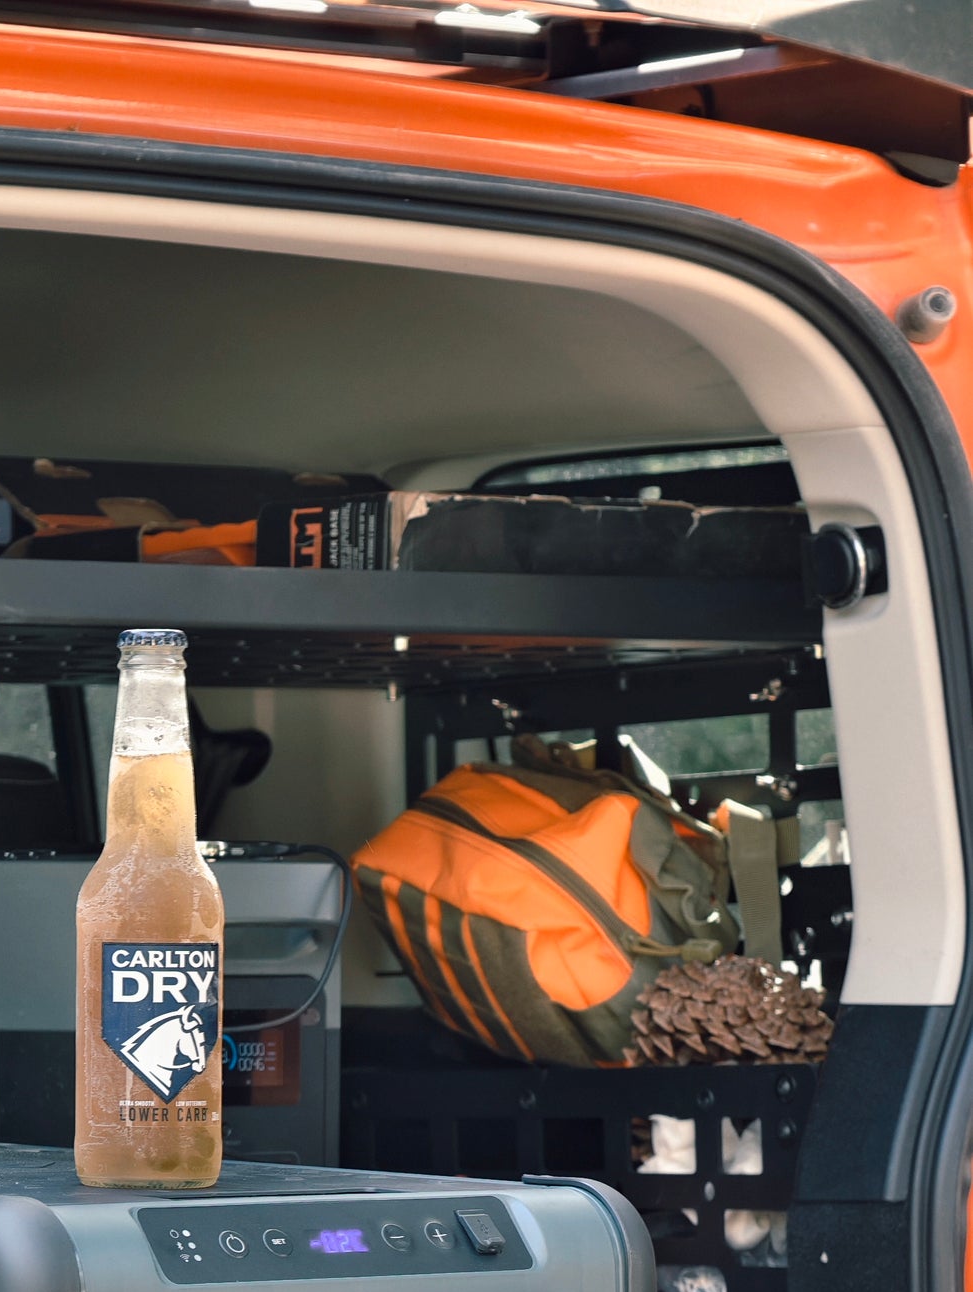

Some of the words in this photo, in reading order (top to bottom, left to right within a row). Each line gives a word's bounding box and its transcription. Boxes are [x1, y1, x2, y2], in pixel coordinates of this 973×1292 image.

[112, 949, 215, 968] CARLTON
[111, 970, 215, 1003] DRY
[119, 1107, 169, 1122] LOWER
[177, 1107, 208, 1122] CARB
